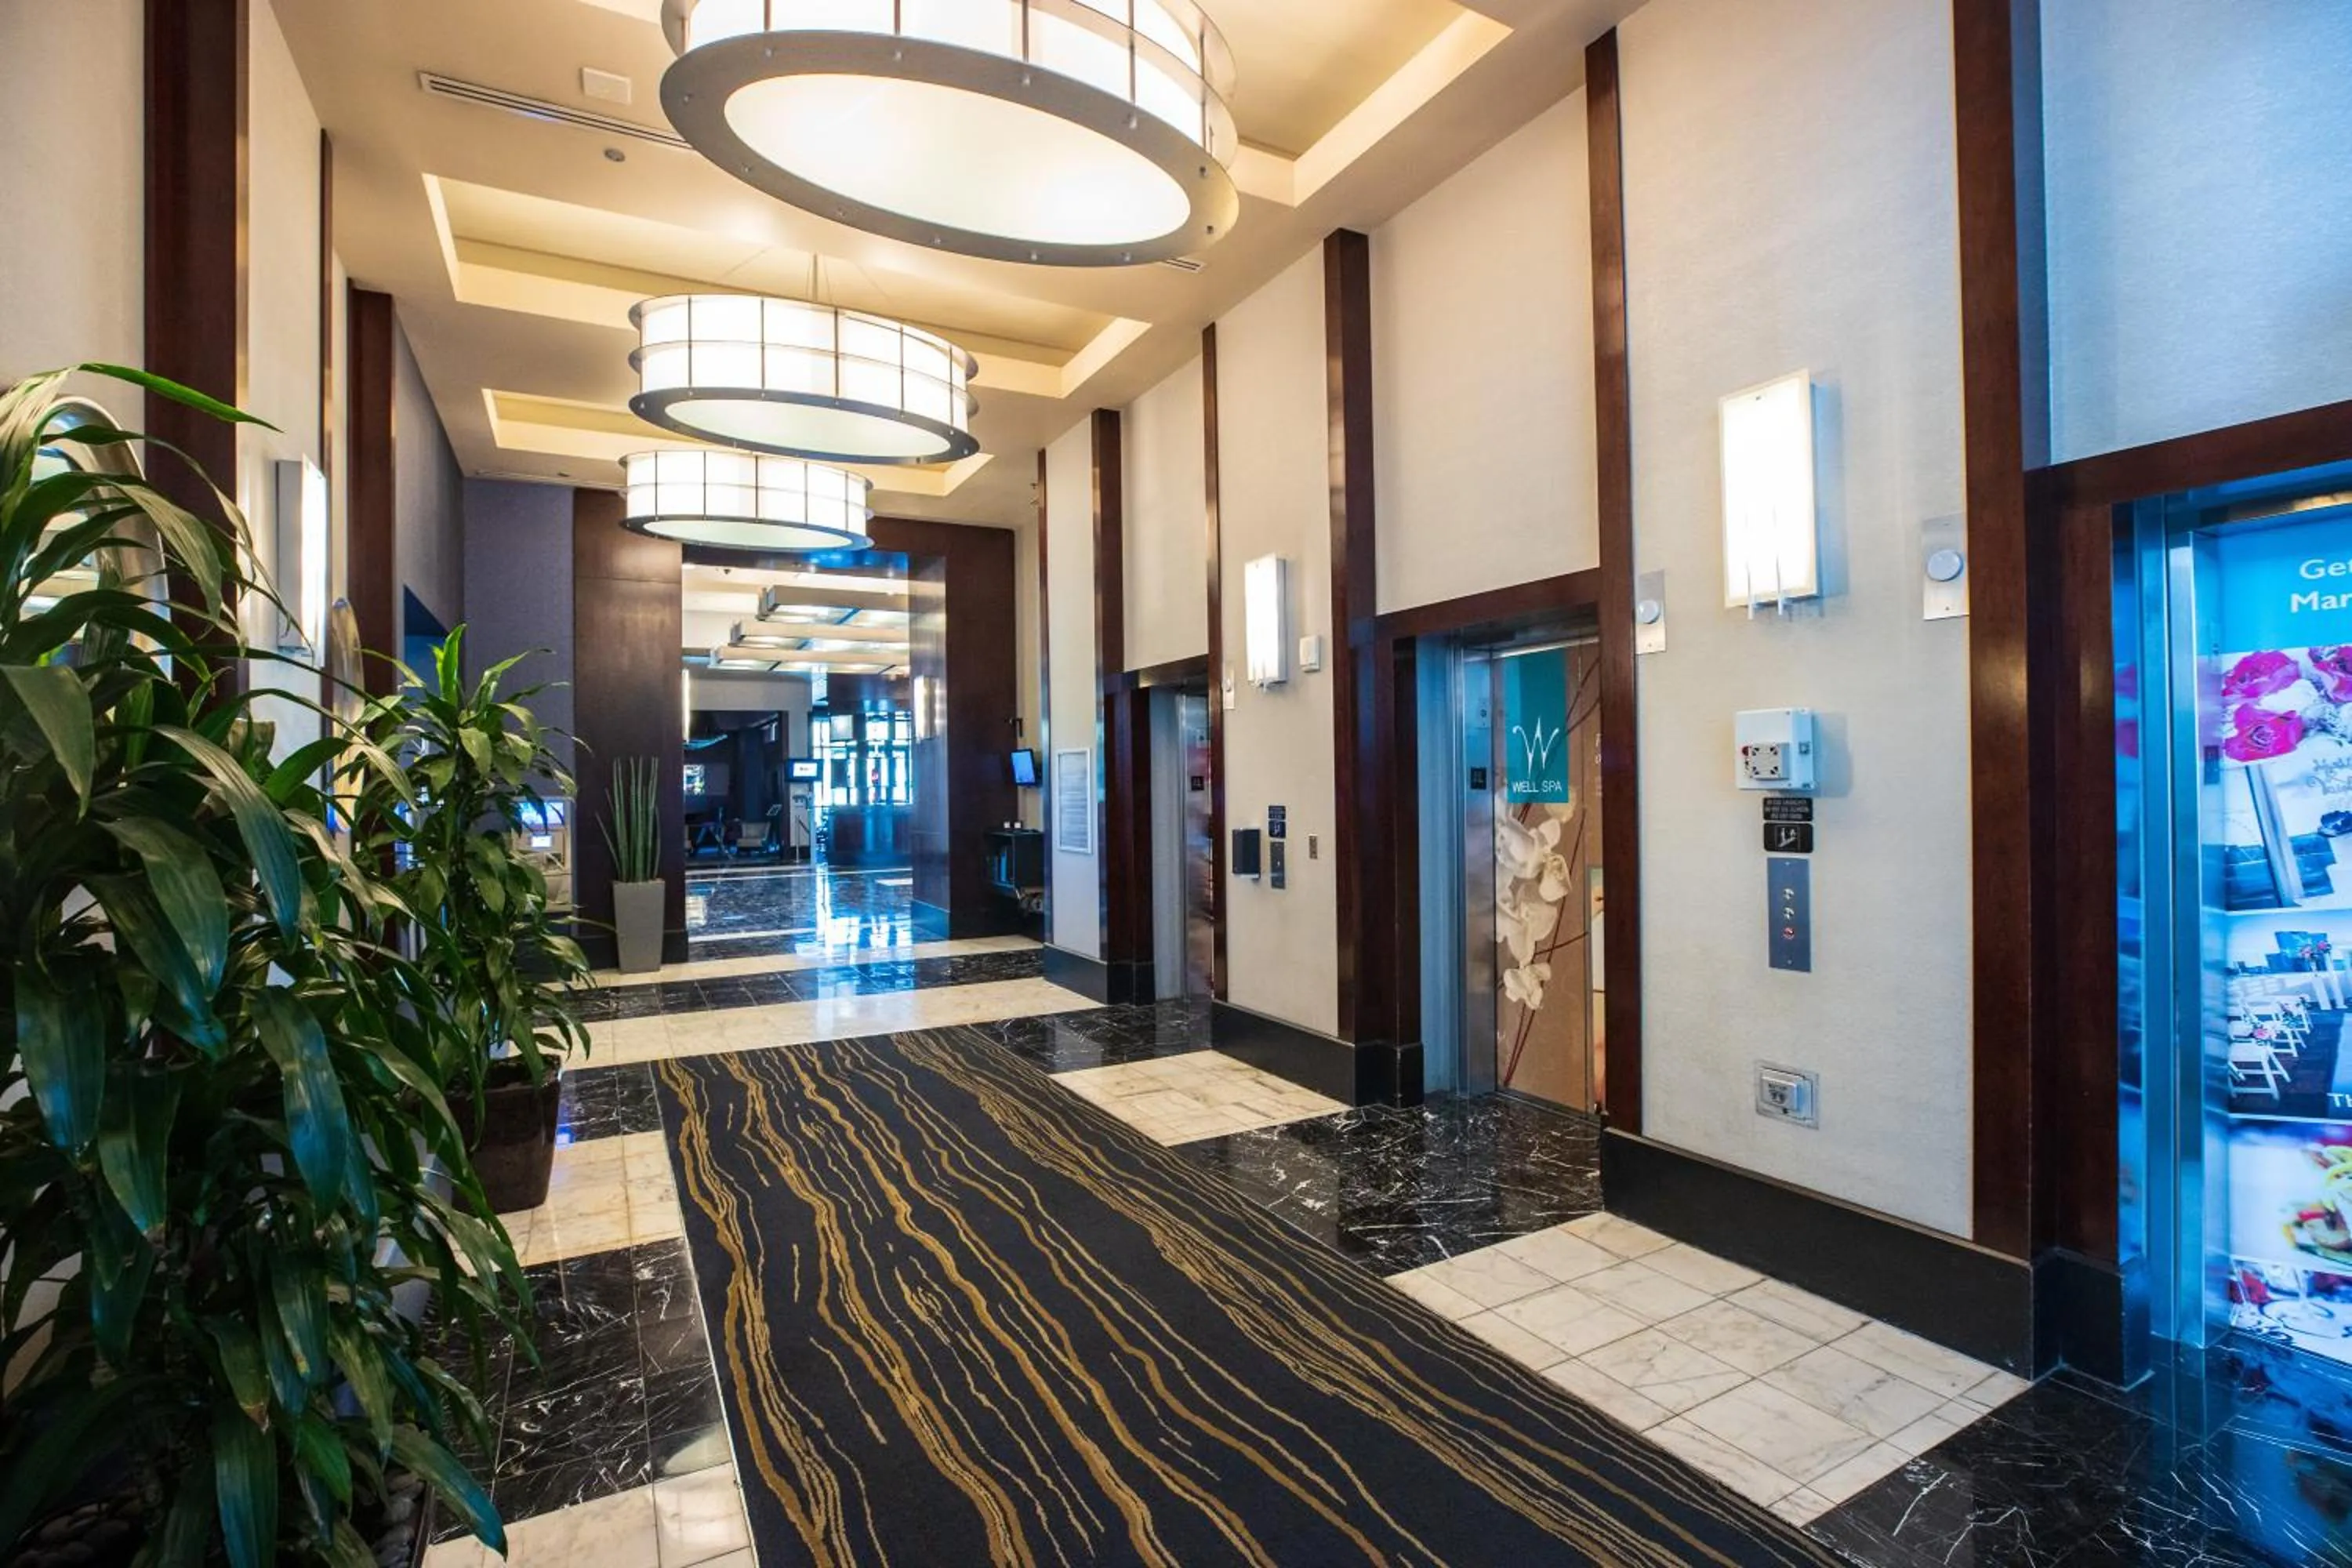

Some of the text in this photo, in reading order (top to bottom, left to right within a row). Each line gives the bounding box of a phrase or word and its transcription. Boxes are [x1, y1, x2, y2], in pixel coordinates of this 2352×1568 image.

[1512, 716, 1559, 779] W
[1512, 780, 1563, 794] WELL SPA
